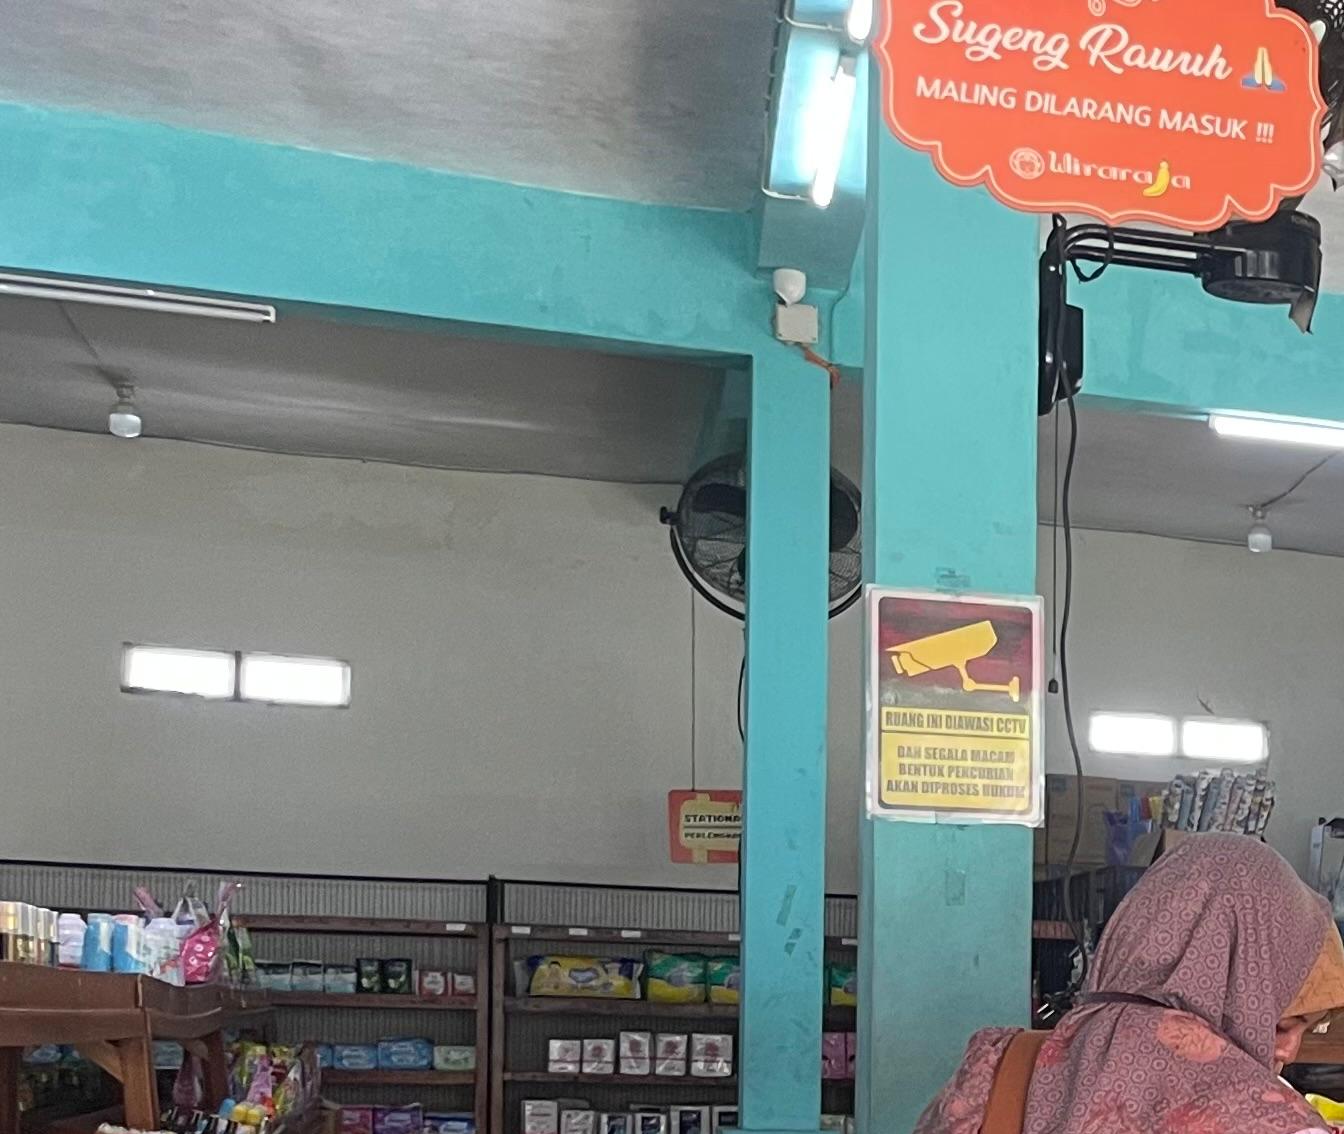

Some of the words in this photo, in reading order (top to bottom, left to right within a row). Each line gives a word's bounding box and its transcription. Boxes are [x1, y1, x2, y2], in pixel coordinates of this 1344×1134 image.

[913, 0, 1069, 71] Sugeng
[916, 76, 1016, 109] MALING
[1024, 91, 1151, 127] DILARANG
[1158, 109, 1248, 140] MASUK
[1256, 122, 1274, 144] !!!
[885, 711, 924, 729] RUANG
[927, 713, 943, 729] INI
[945, 714, 994, 732] DIAWASI
[996, 717, 1027, 734] CCTV
[924, 747, 969, 761] SEGALA
[899, 763, 945, 778] BENTUK
[886, 780, 918, 793] AKAN
[921, 781, 980, 797] DIPROSES
